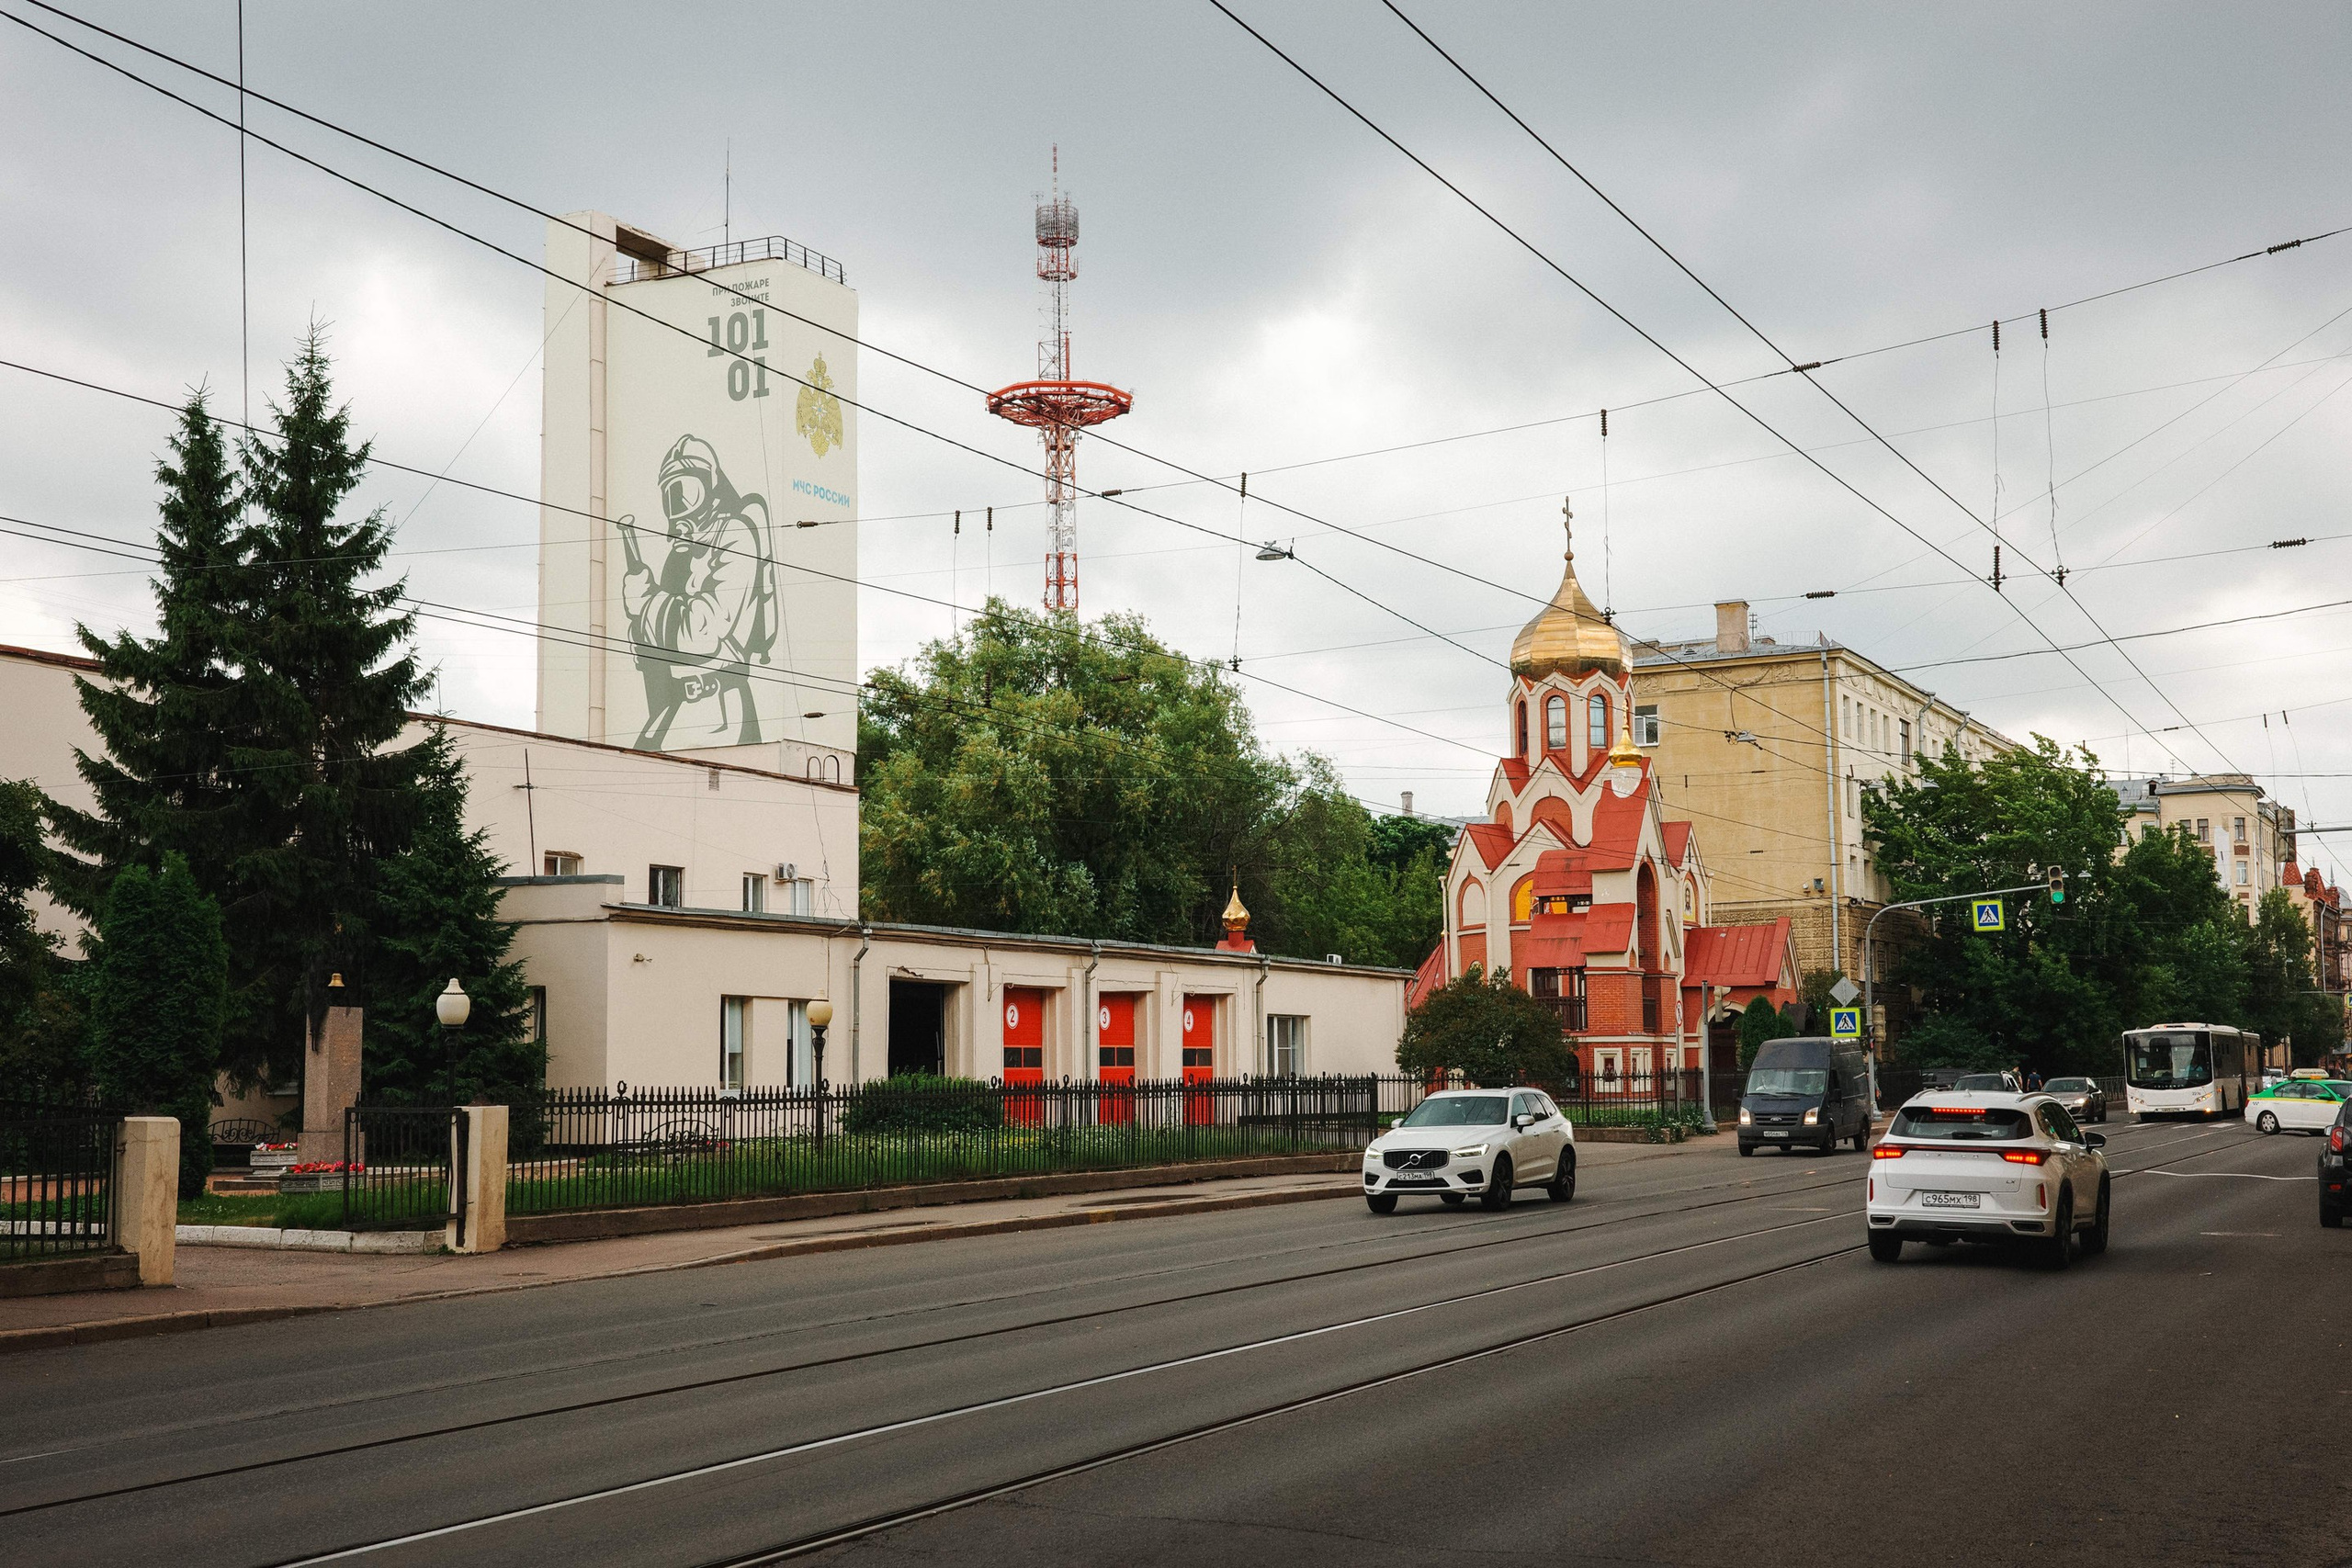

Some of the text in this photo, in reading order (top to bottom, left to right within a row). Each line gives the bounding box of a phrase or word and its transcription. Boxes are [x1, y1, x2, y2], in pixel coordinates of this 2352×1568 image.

[712, 277, 770, 297] ПРИ ПОЖАРЕ
[730, 292, 770, 308] ЗВОНИТЕ
[707, 309, 769, 357] 101
[728, 356, 770, 401] 01
[793, 479, 850, 508] МЧС РОССИИ
[1010, 1009, 1015, 1023] 2
[1102, 1011, 1107, 1024] 3
[1186, 1015, 1191, 1026] 4
[1926, 1194, 1961, 1204] С965МХ
